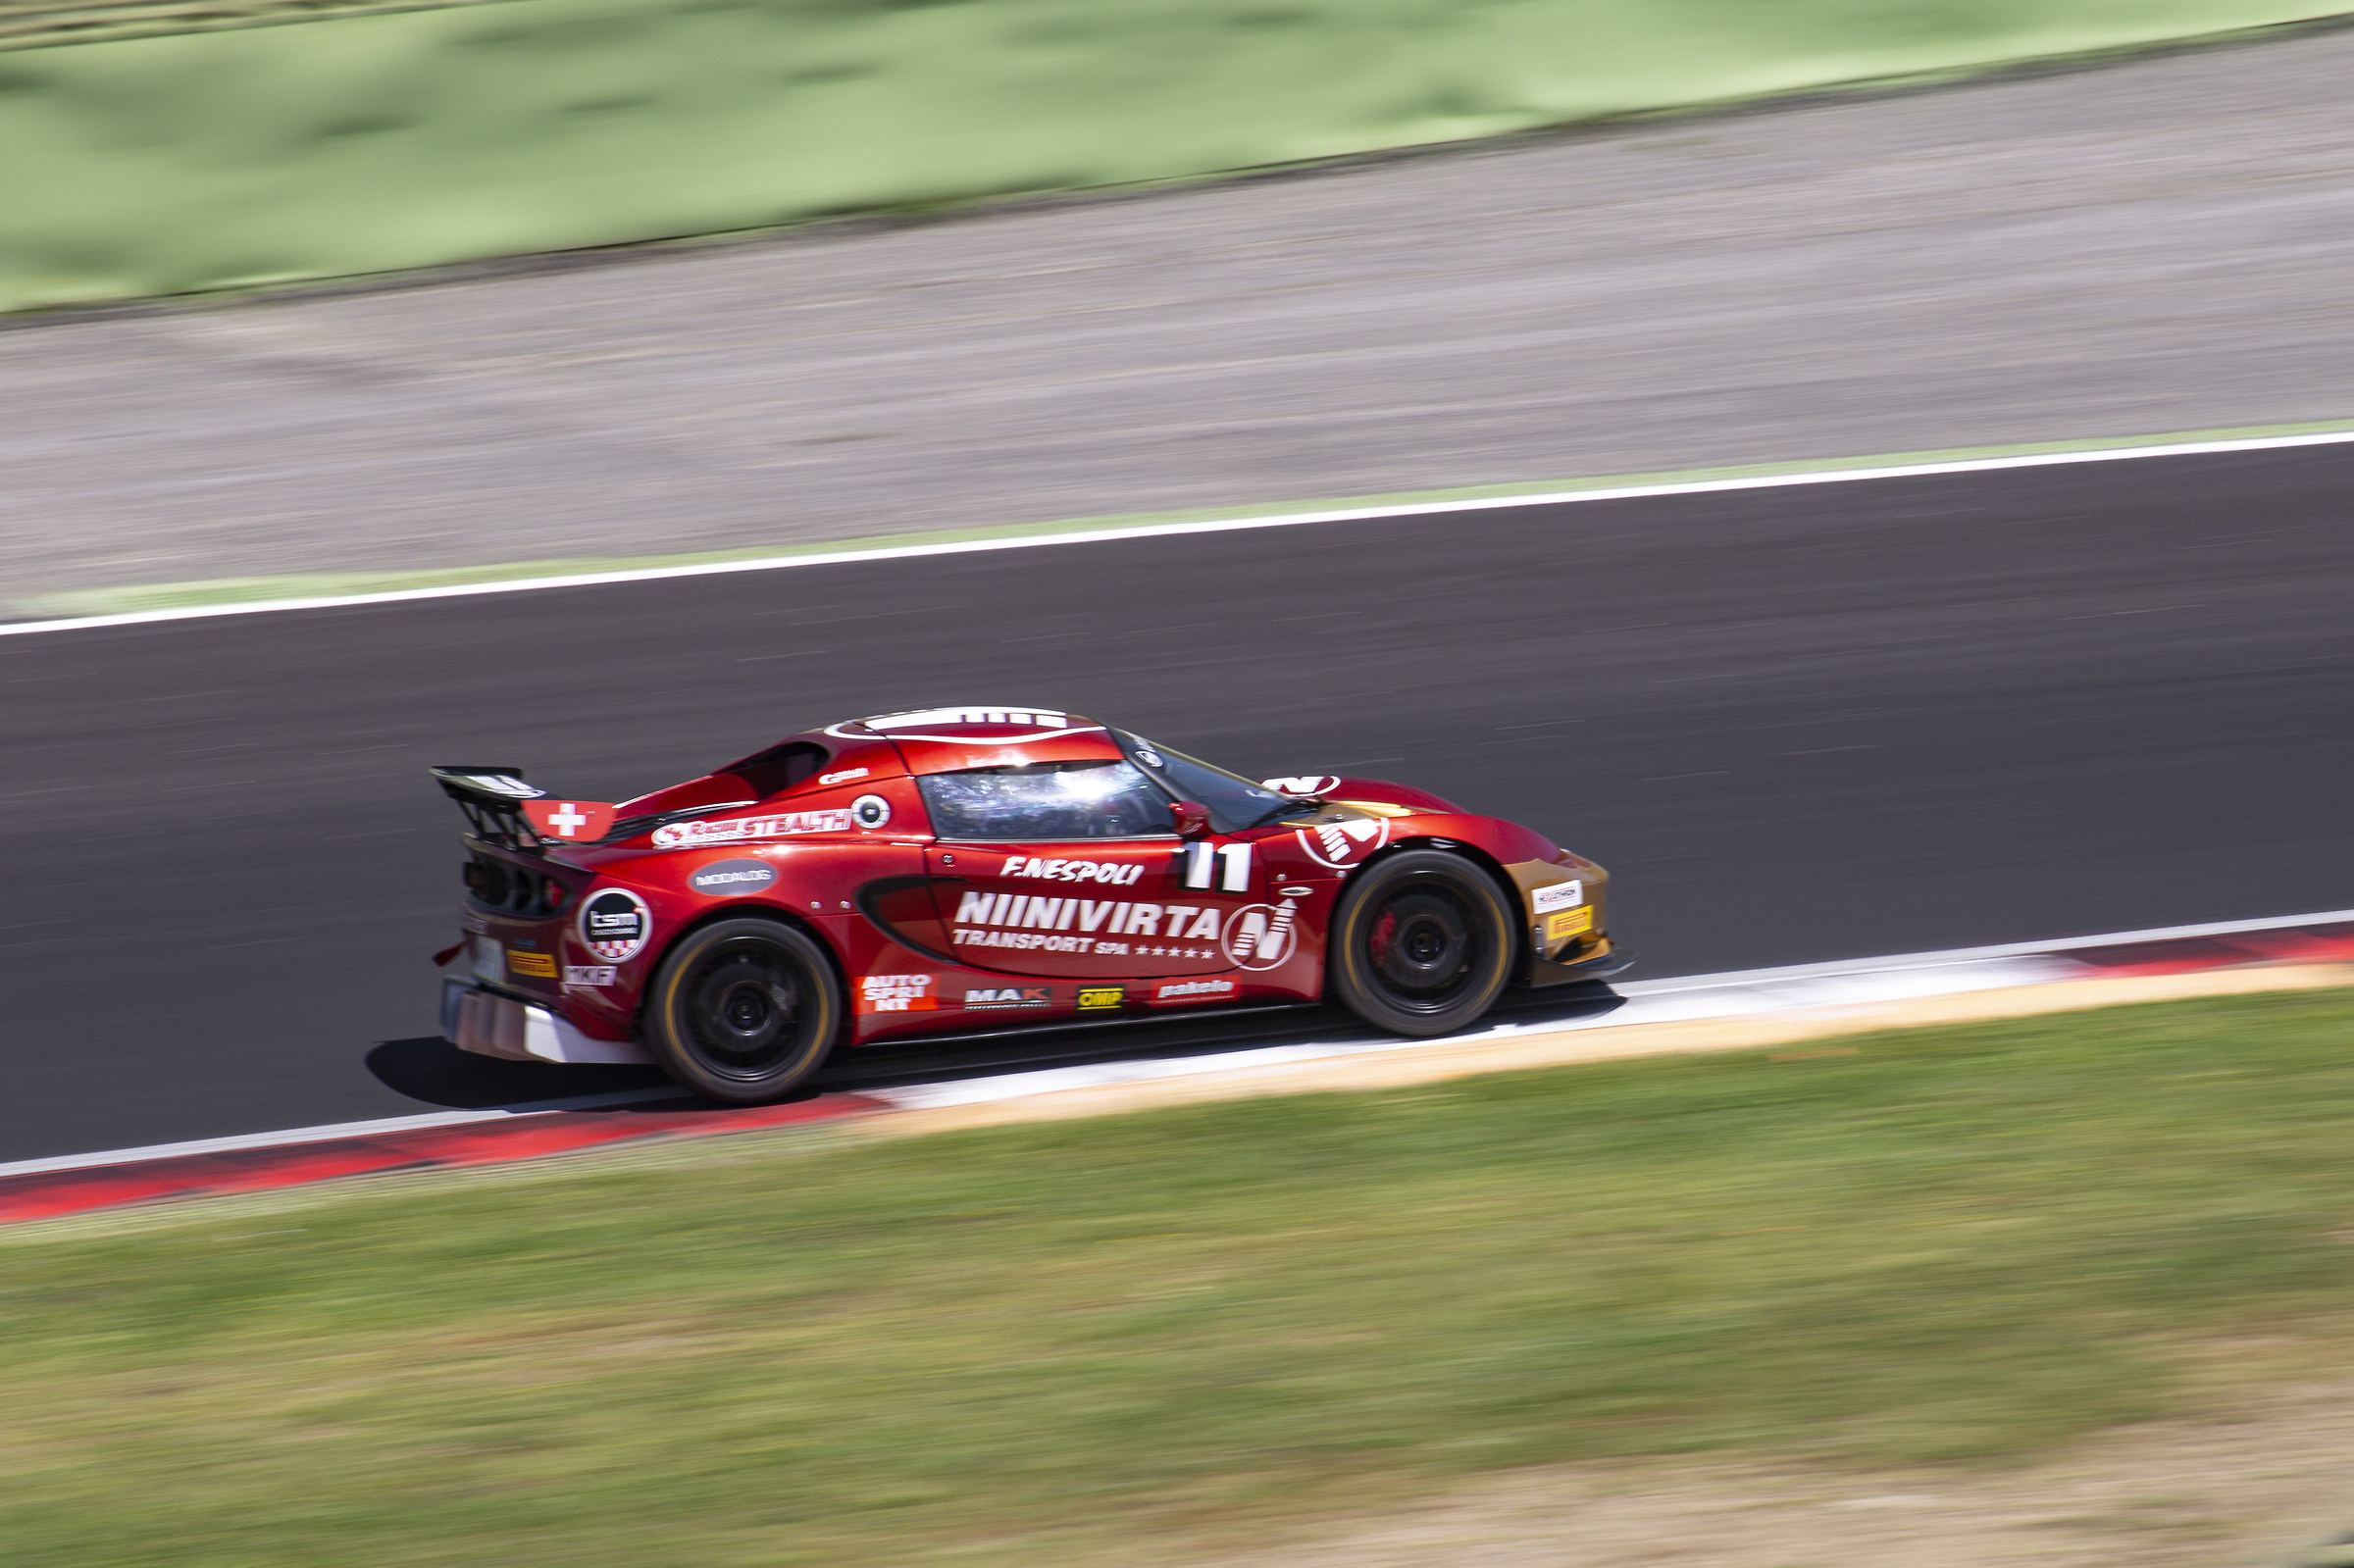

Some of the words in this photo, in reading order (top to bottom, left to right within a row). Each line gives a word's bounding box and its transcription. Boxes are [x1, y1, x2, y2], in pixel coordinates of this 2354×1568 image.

[742, 809, 850, 836] STEALTH
[1000, 856, 1144, 885] F.NESPOLI
[1185, 841, 1253, 891] 11
[590, 910, 639, 928] tsm
[953, 891, 1220, 939] NIINIVIRTA
[952, 929, 1095, 953] TRANSPORT
[1094, 941, 1129, 955] SPA
[861, 975, 931, 988] AUTO
[1157, 980, 1234, 998] pakelo
[864, 986, 925, 1000] SPRI
[965, 988, 1047, 1002] MAK
[1079, 992, 1123, 1007] OMP
[875, 998, 910, 1011] NT
